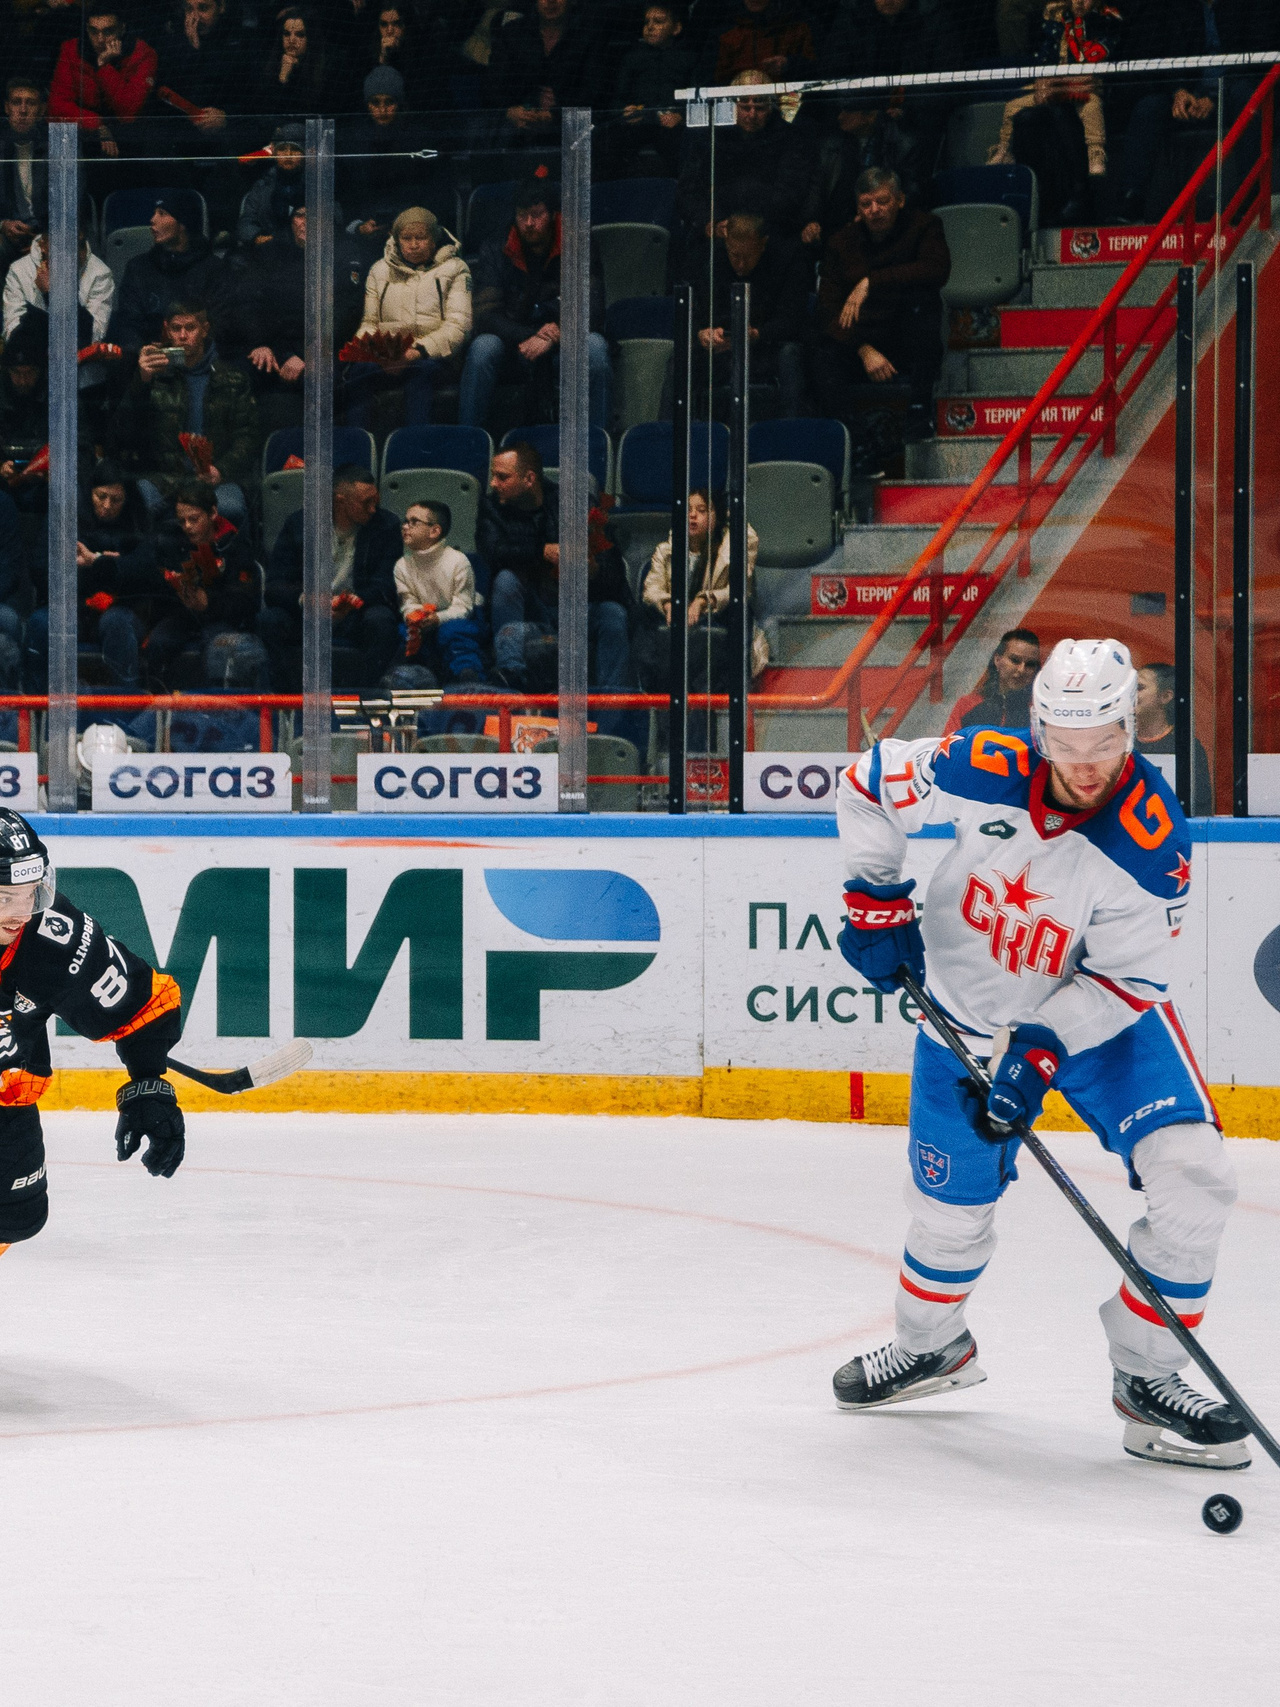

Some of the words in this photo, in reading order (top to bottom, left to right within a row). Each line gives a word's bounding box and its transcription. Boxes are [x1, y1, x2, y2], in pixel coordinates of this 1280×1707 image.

[1108, 234, 1177, 251] ТЕРРИТИЯ
[1065, 672, 1087, 687] 77
[884, 760, 919, 809] 77
[9, 833, 30, 851] 87
[848, 907, 914, 924] CCM
[960, 872, 1075, 978] СКА
[52, 867, 661, 1040] МИР
[68, 912, 95, 975] OLIMPBET
[90, 935, 128, 1008] 87
[746, 984, 920, 1025] систе
[1118, 1096, 1177, 1134] CCM
[11, 1162, 47, 1190] BAU
